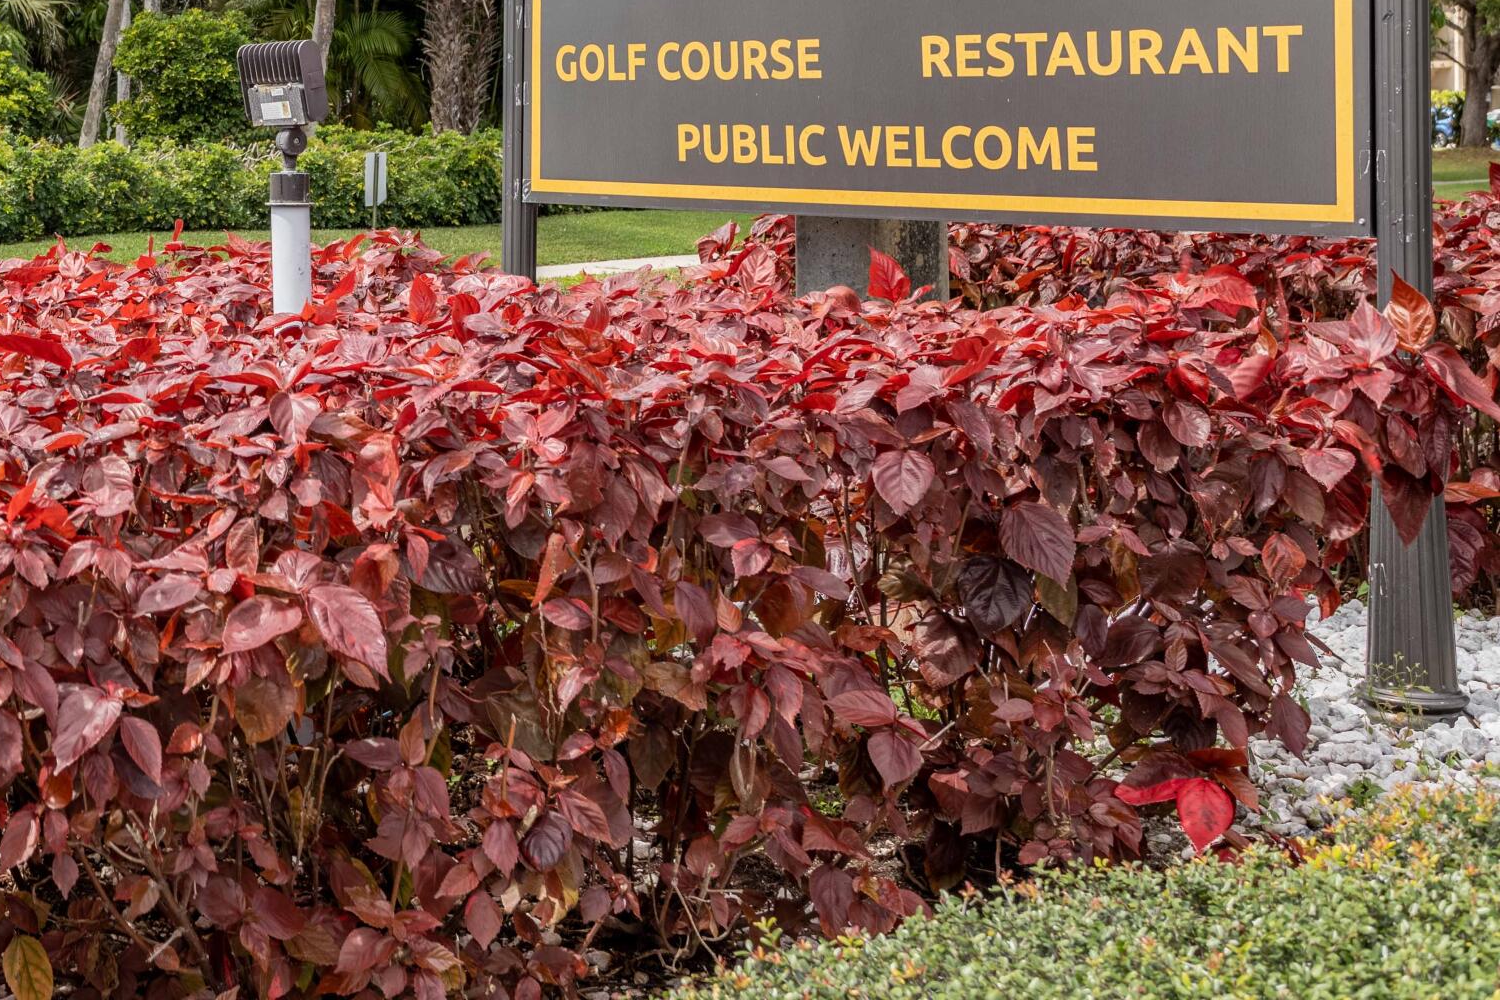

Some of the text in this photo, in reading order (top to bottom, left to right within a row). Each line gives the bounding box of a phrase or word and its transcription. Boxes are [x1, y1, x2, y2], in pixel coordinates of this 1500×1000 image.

[555, 38, 823, 83] GOLF COURSE
[920, 24, 1304, 78] RESTAURANT
[677, 123, 1099, 172] PUBLIC WELCOME
